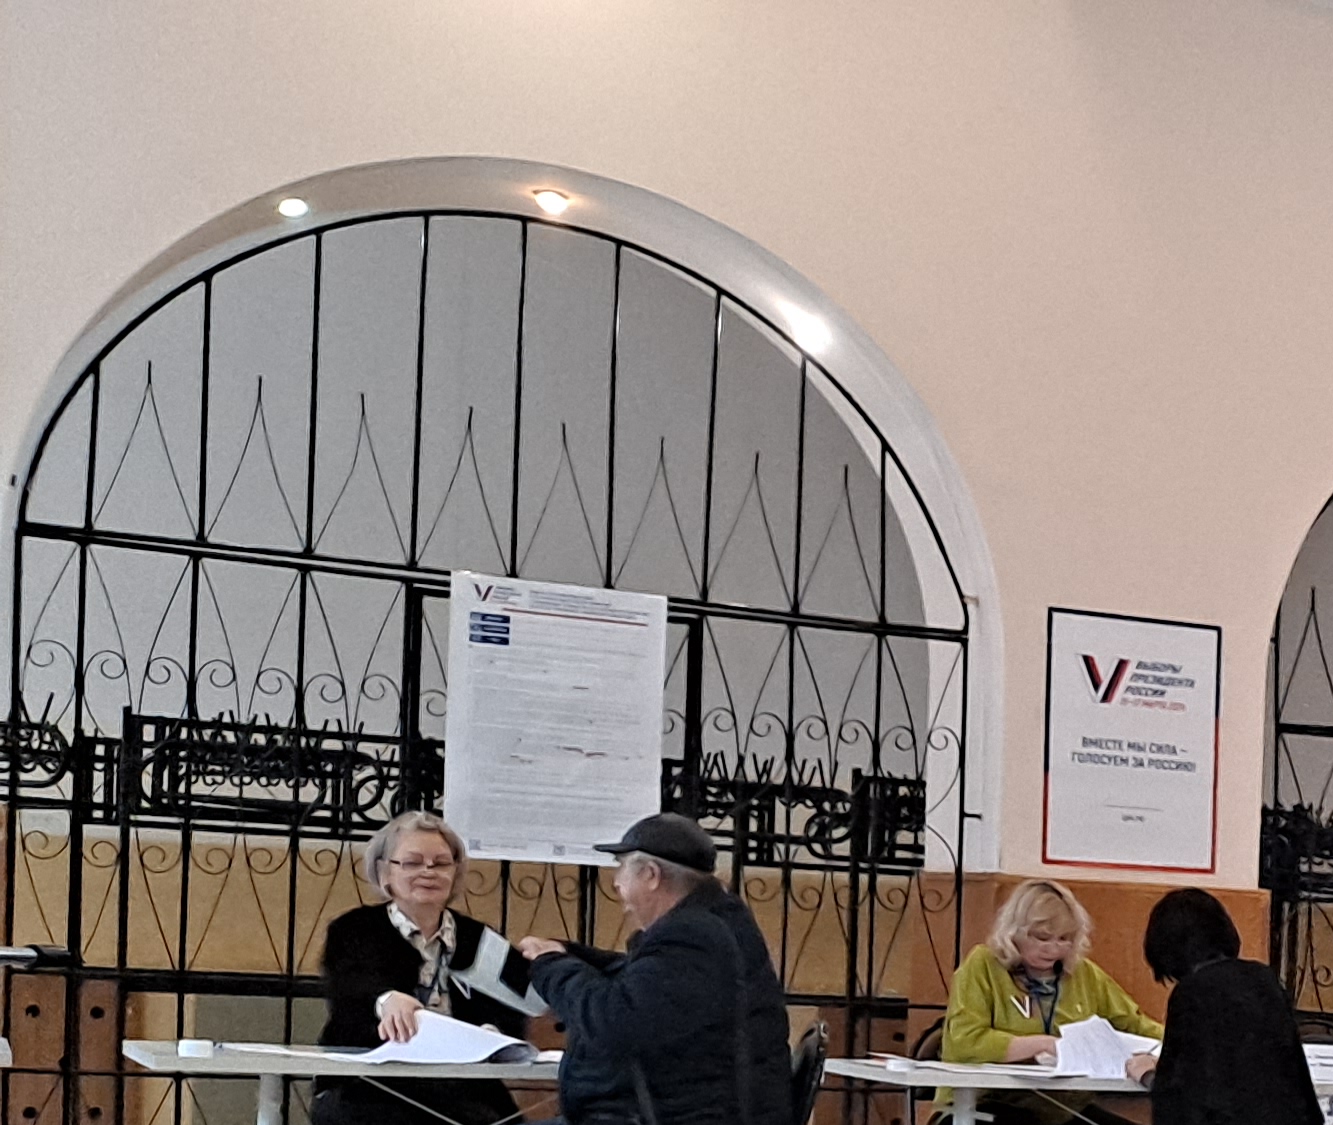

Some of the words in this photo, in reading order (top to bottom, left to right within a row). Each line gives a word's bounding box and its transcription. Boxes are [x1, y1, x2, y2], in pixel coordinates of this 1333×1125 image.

[1130, 672, 1195, 688] ПРЕЗИДЕНТА
[1124, 685, 1167, 697] РОССИИ
[1082, 736, 1123, 751] ВМЕСТЕ
[1127, 741, 1146, 753] МЫ
[1149, 742, 1178, 756] СИЛА
[1072, 752, 1129, 767] ГОЛОСУЕМ
[1131, 757, 1145, 768] ЗА
